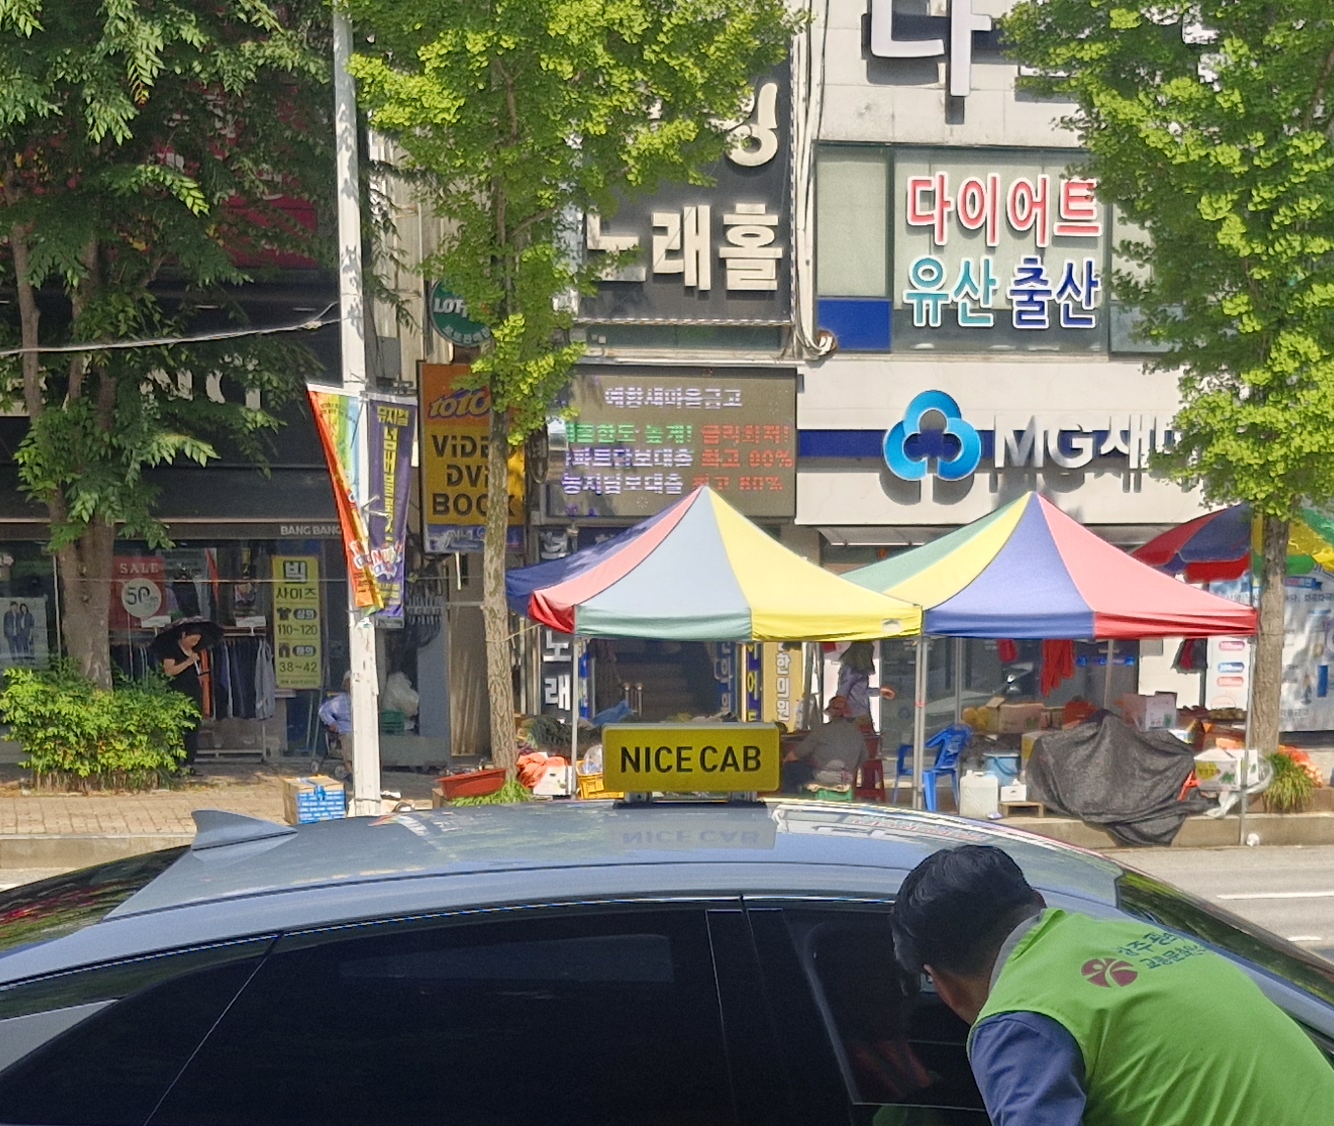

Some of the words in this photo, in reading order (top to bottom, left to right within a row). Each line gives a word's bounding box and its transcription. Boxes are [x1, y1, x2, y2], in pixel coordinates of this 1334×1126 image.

[906, 172, 1102, 247] 다이어트
[904, 255, 997, 328] 유산
[1008, 255, 1098, 328] 출산
[377, 405, 409, 427] 뮤지컬
[280, 525, 311, 535] BANG
[120, 562, 159, 574] SALE
[276, 587, 316, 600] 사이즈
[278, 624, 317, 636] 110~120
[279, 661, 317, 673] 38~42
[620, 746, 693, 774] NICE
[699, 746, 762, 774] CAB
